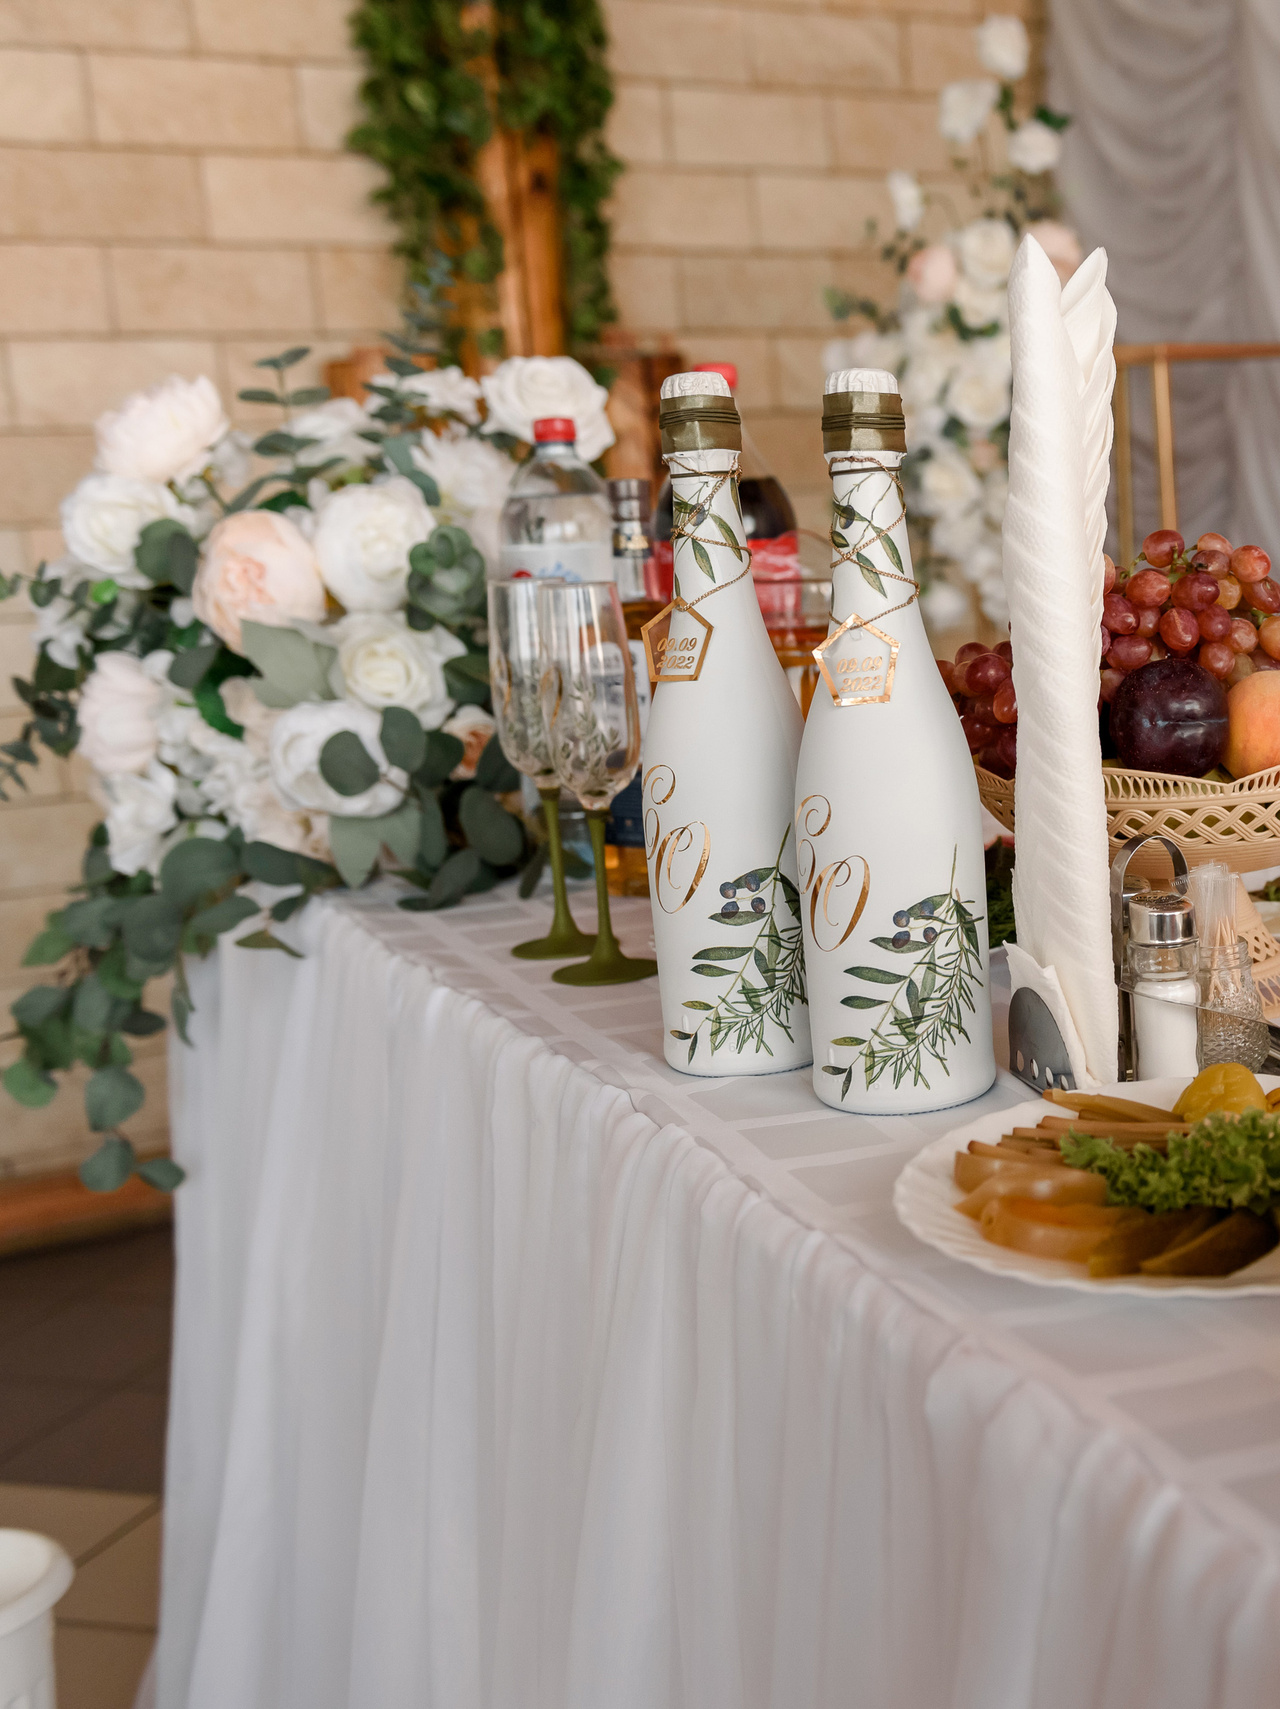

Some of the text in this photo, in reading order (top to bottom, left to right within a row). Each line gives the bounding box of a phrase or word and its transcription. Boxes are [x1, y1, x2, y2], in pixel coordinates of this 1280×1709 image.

[657, 637, 698, 652] 09.09
[656, 655, 695, 669] 2022
[836, 656, 883, 674] 09.09
[840, 675, 883, 693] 2022
